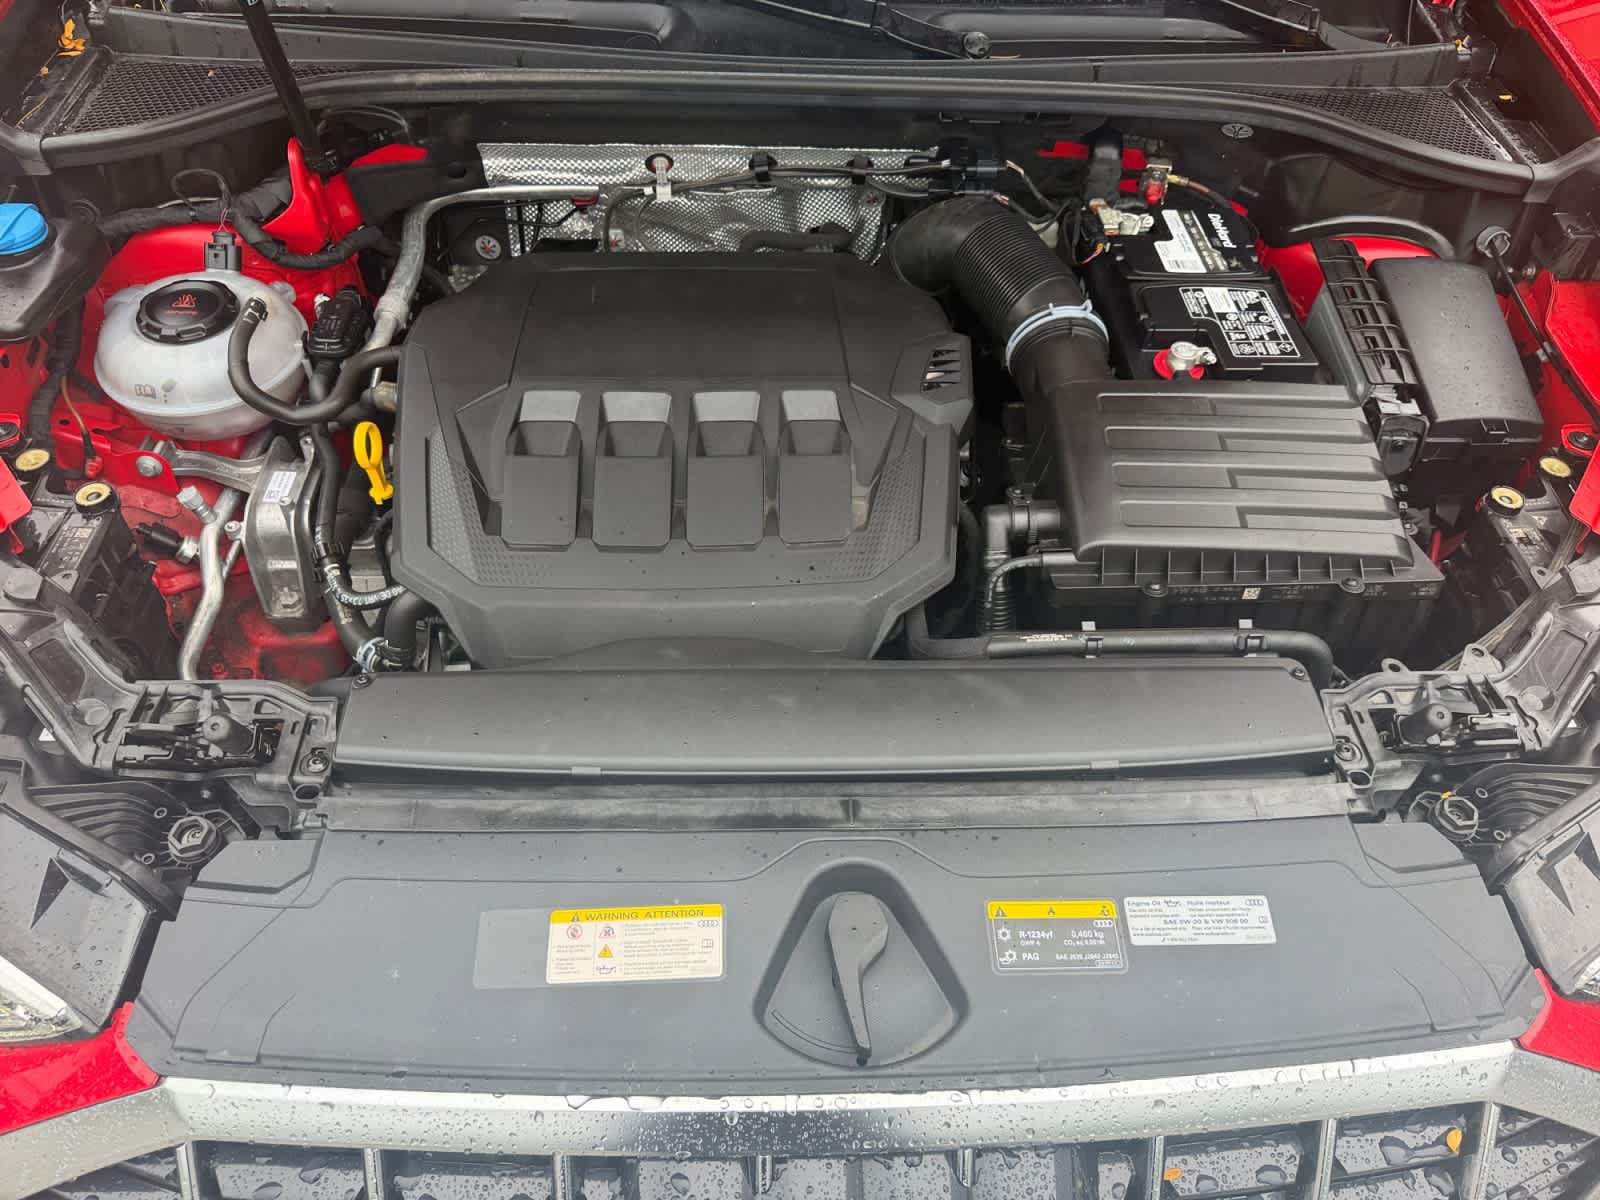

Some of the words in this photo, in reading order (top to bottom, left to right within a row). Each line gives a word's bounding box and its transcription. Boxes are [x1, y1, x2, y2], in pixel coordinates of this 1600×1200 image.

[1207, 212, 1237, 248] DieHard
[584, 911, 639, 921] WARNING
[643, 909, 705, 920] ATTENTION
[1018, 930, 1053, 941] R-1234yf
[1022, 952, 1041, 961] PAG
